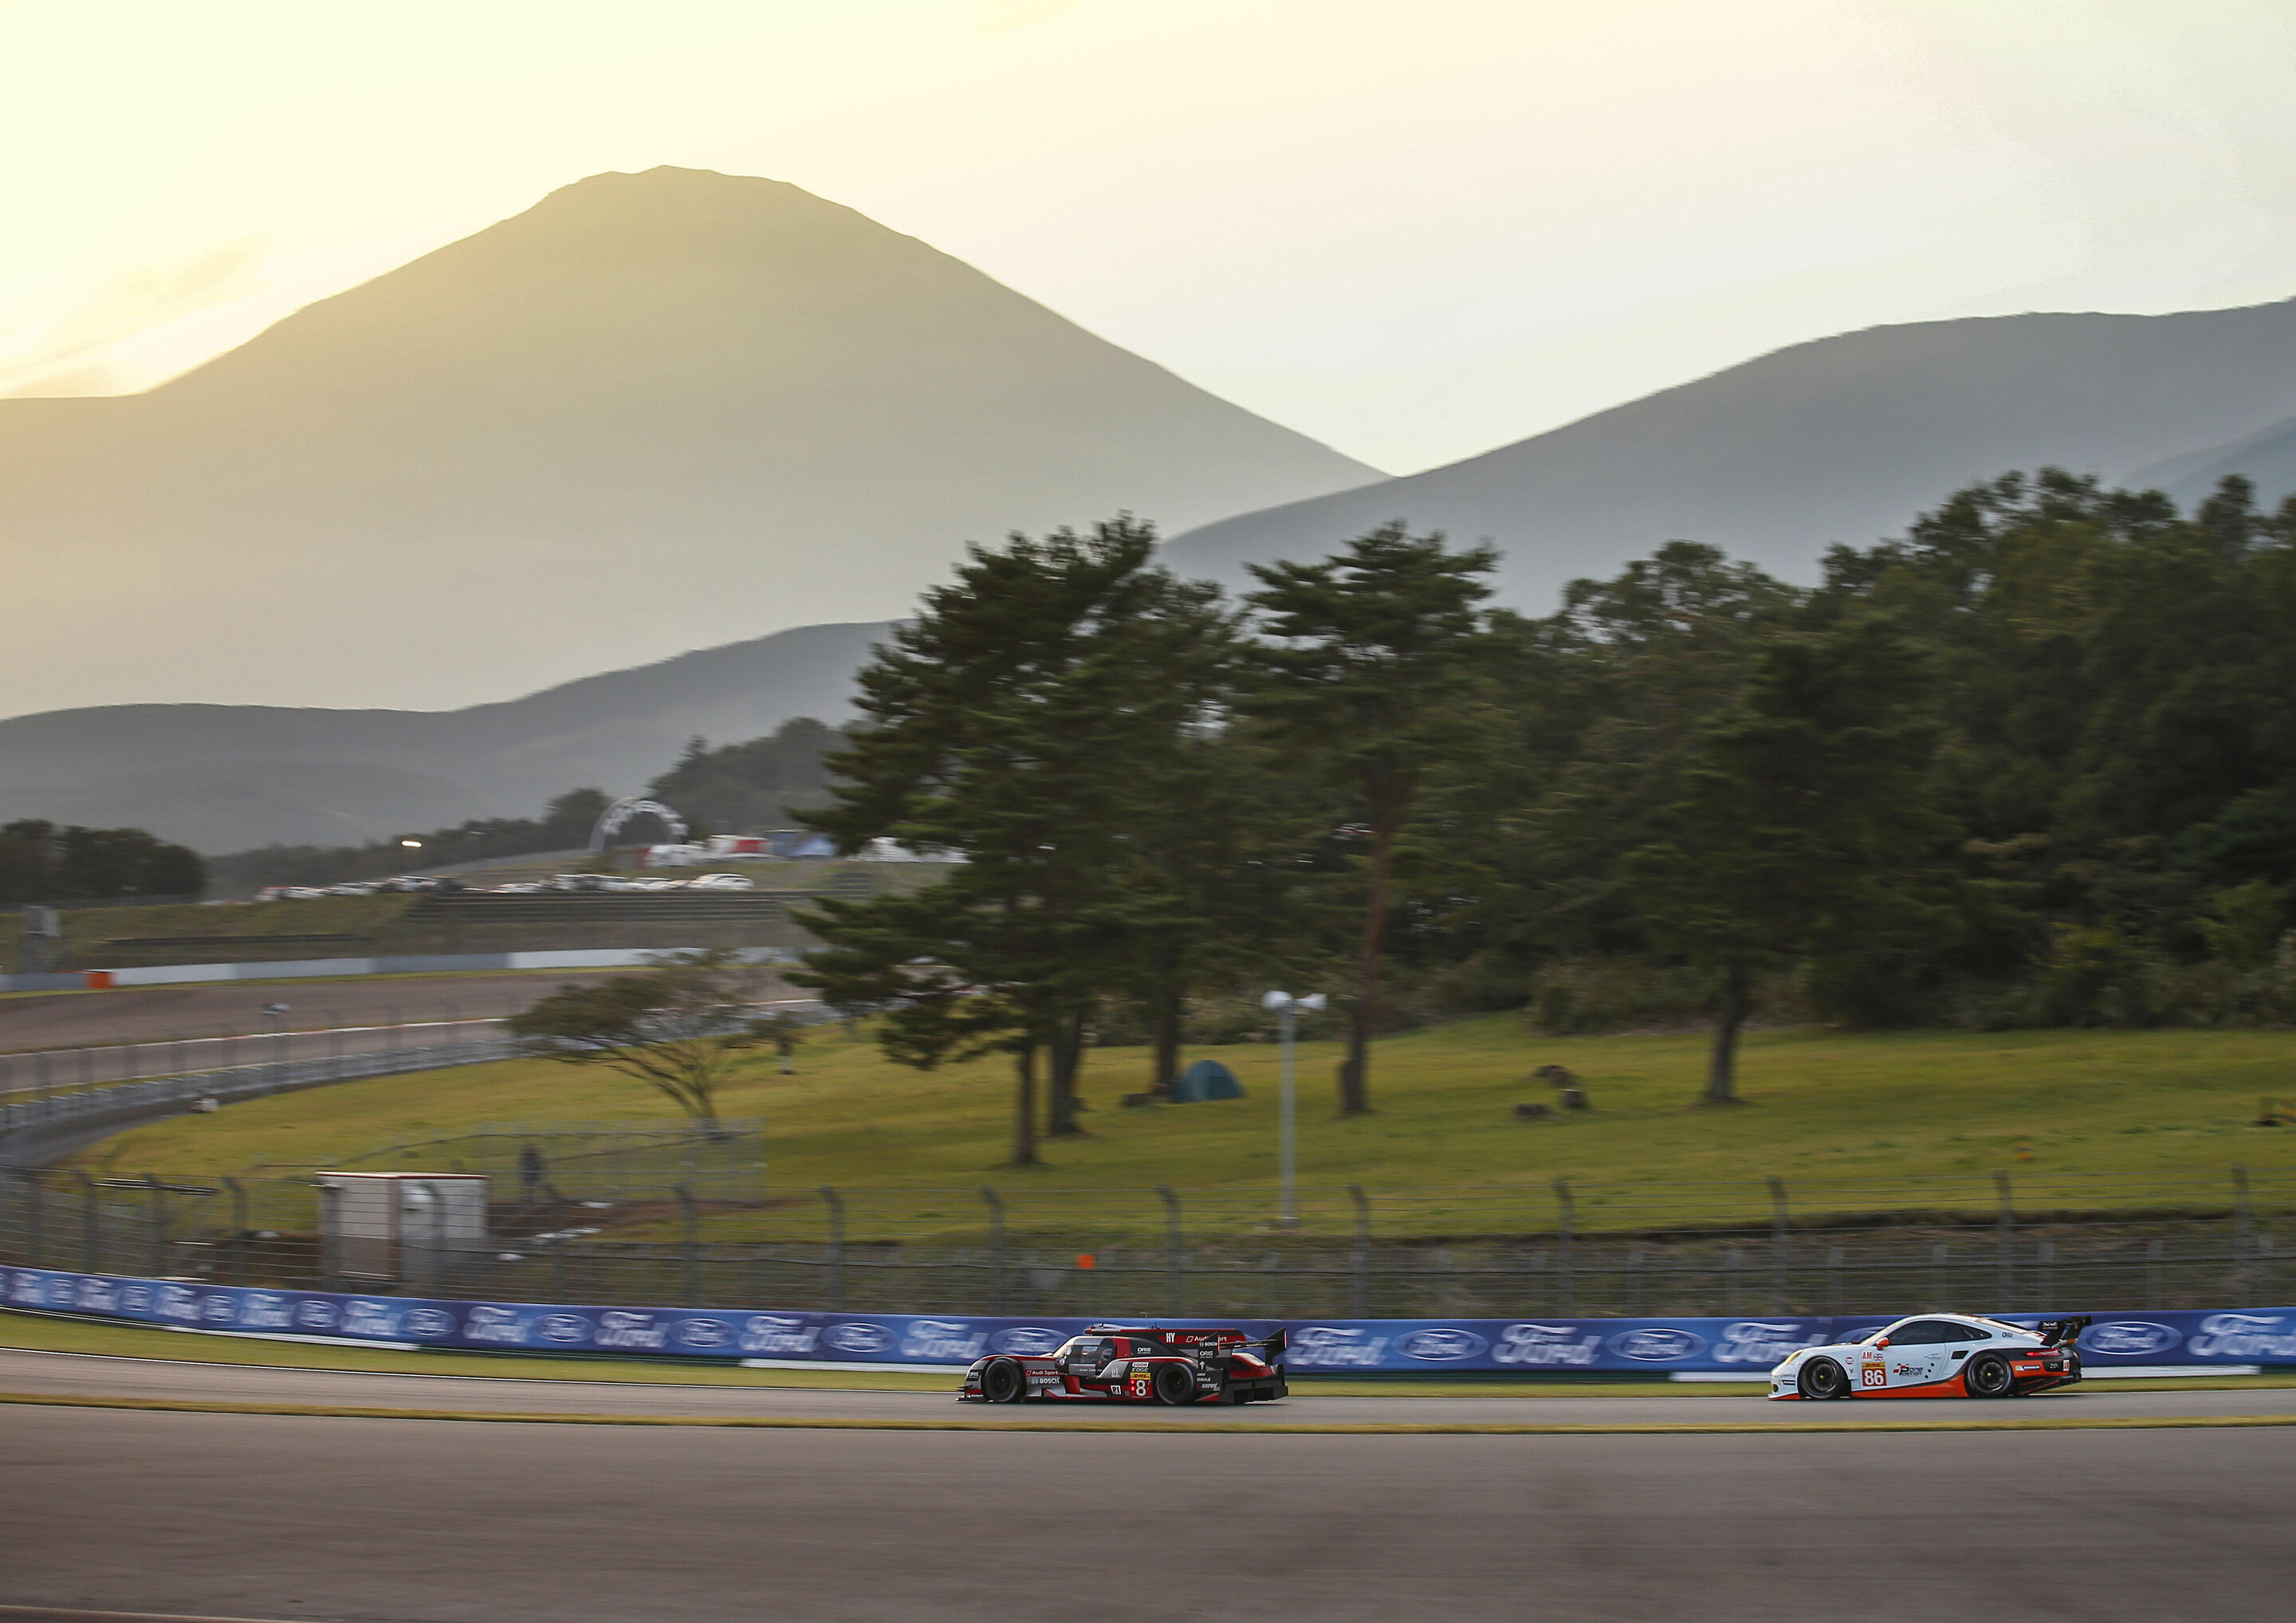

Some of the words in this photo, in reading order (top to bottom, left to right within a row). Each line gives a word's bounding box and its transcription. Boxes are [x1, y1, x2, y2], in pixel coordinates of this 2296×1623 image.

[594, 1311, 671, 1348] Ford
[738, 1315, 823, 1353] Ford
[899, 1319, 990, 1359] Ford
[1166, 1332, 1176, 1343] HY
[1284, 1326, 1390, 1366] Ford
[1491, 1323, 1603, 1365] Ford
[1135, 1380, 1146, 1397] 8
[1864, 1370, 1885, 1385] 86
